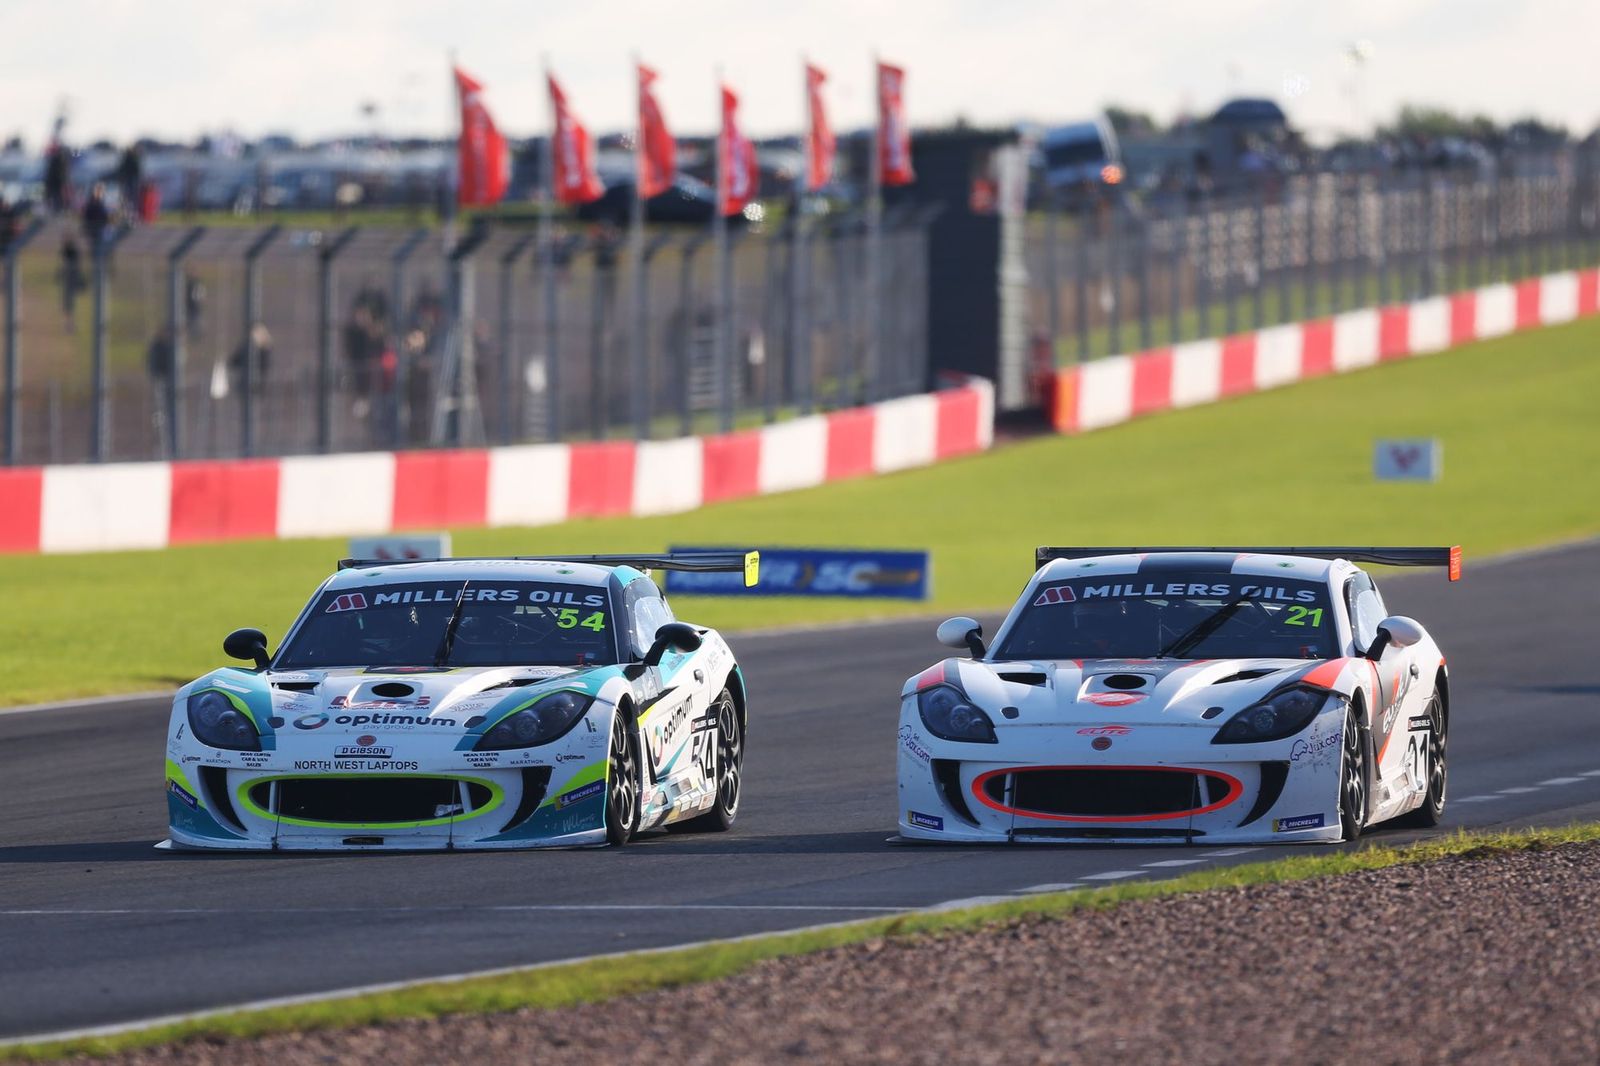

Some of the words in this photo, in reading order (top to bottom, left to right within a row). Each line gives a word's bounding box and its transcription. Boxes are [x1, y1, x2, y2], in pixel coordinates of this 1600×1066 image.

[374, 589, 519, 605] MILLERS
[529, 591, 604, 607] OILS
[1083, 583, 1230, 598] MILLERS
[1240, 585, 1316, 602] OILS
[557, 608, 605, 632] 54
[1284, 605, 1323, 627] 21
[335, 713, 456, 726] optimum
[664, 693, 693, 744] optimum
[350, 747, 387, 755] GIBSON
[294, 761, 331, 770] NORTH
[334, 761, 365, 770] WEST
[367, 761, 419, 771] LAPTOPS
[570, 785, 600, 799] MICHELIN
[1288, 818, 1319, 827] MICHELIN
